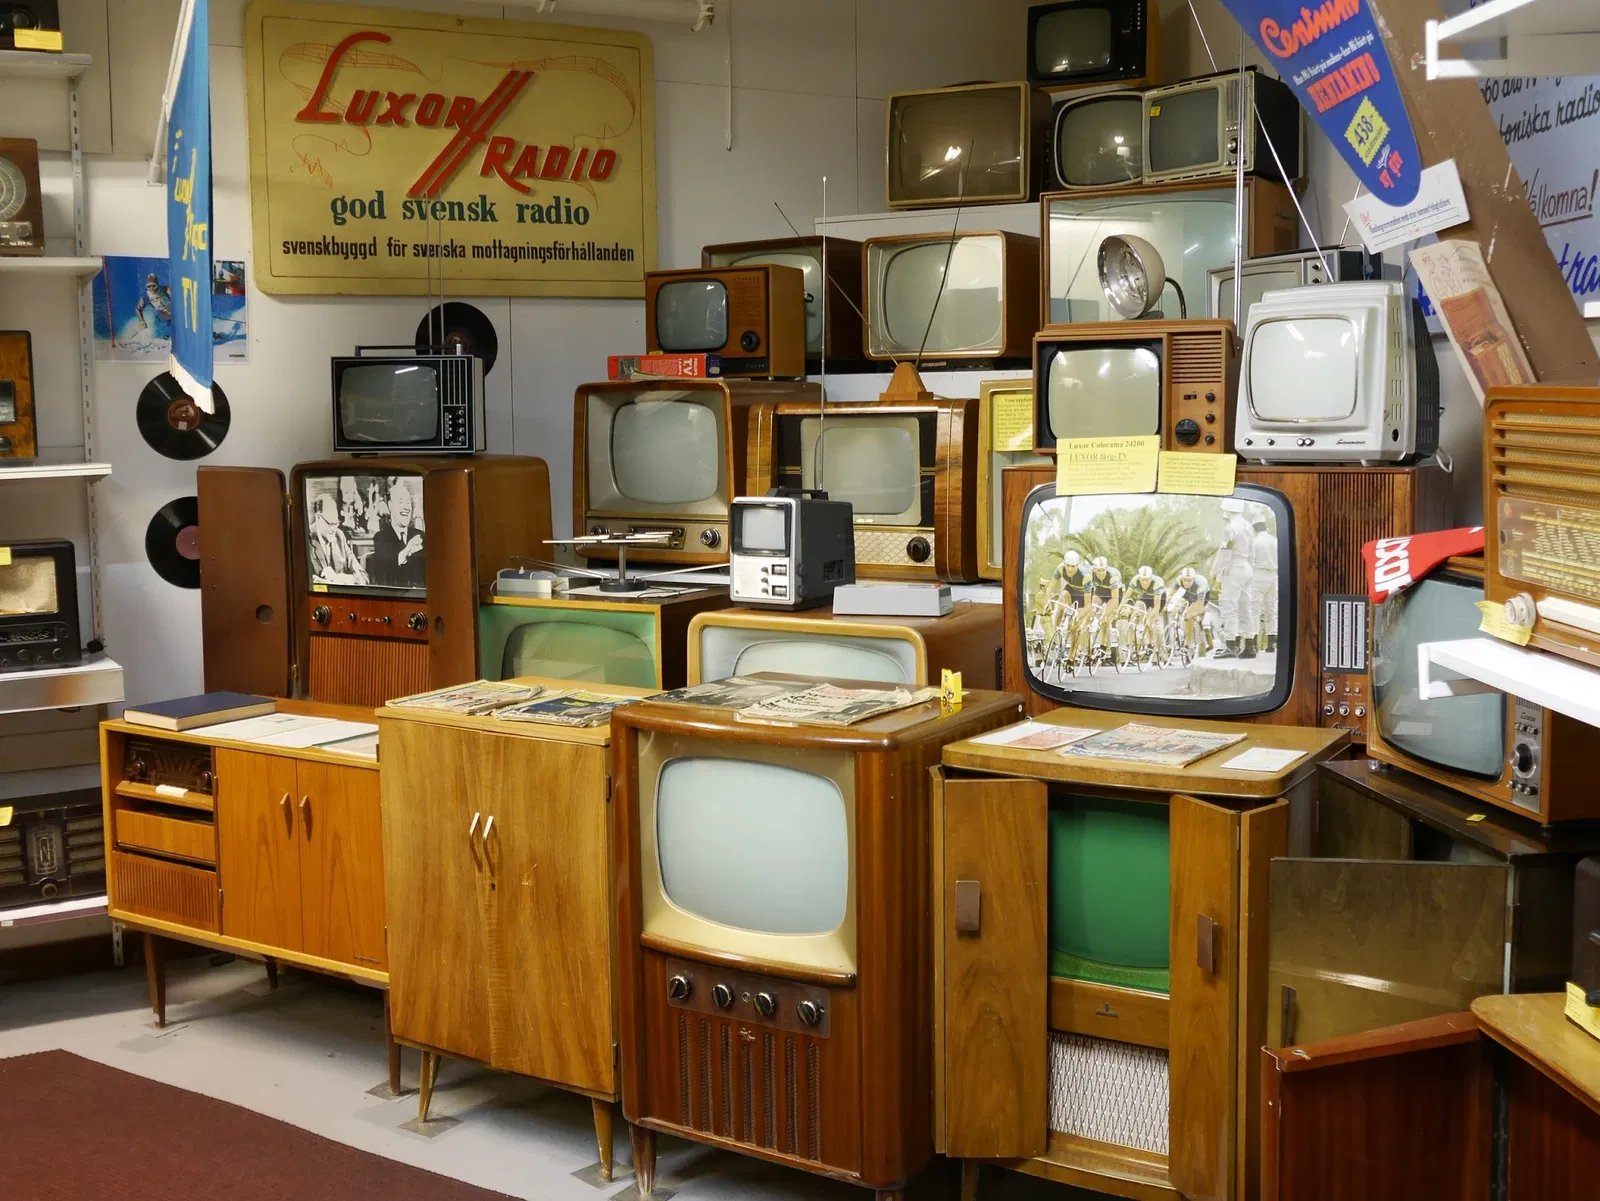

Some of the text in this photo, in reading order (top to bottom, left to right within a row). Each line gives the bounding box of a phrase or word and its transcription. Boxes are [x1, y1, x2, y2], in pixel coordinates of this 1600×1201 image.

[330, 191, 590, 226] god svensk radio
[282, 235, 634, 263] svenskbyggd för svenska mottagningsförhållanden
